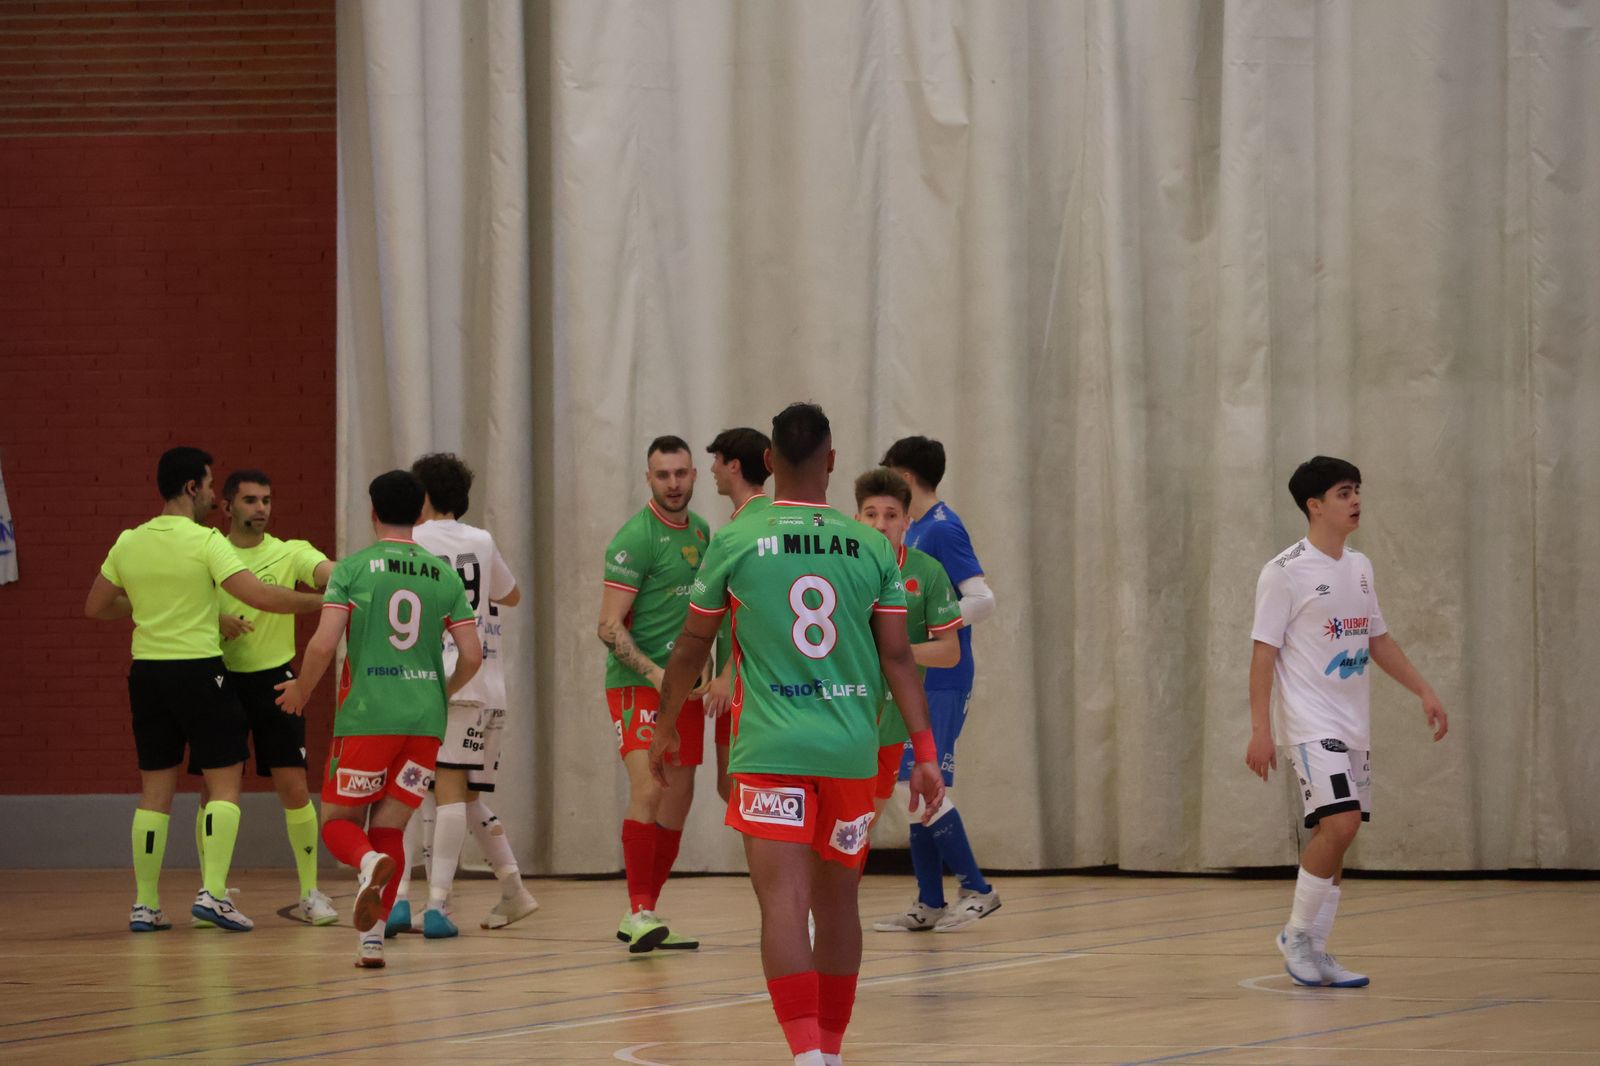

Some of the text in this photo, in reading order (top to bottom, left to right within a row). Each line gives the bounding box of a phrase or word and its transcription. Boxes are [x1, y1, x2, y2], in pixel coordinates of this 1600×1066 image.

[784, 533, 860, 559] MILAR
[388, 559, 440, 581] MILAR
[388, 588, 422, 651] 9
[788, 573, 838, 660] 8
[367, 666, 400, 676] FISIO
[770, 684, 813, 698] FISIO
[746, 792, 799, 819] AMAQ
